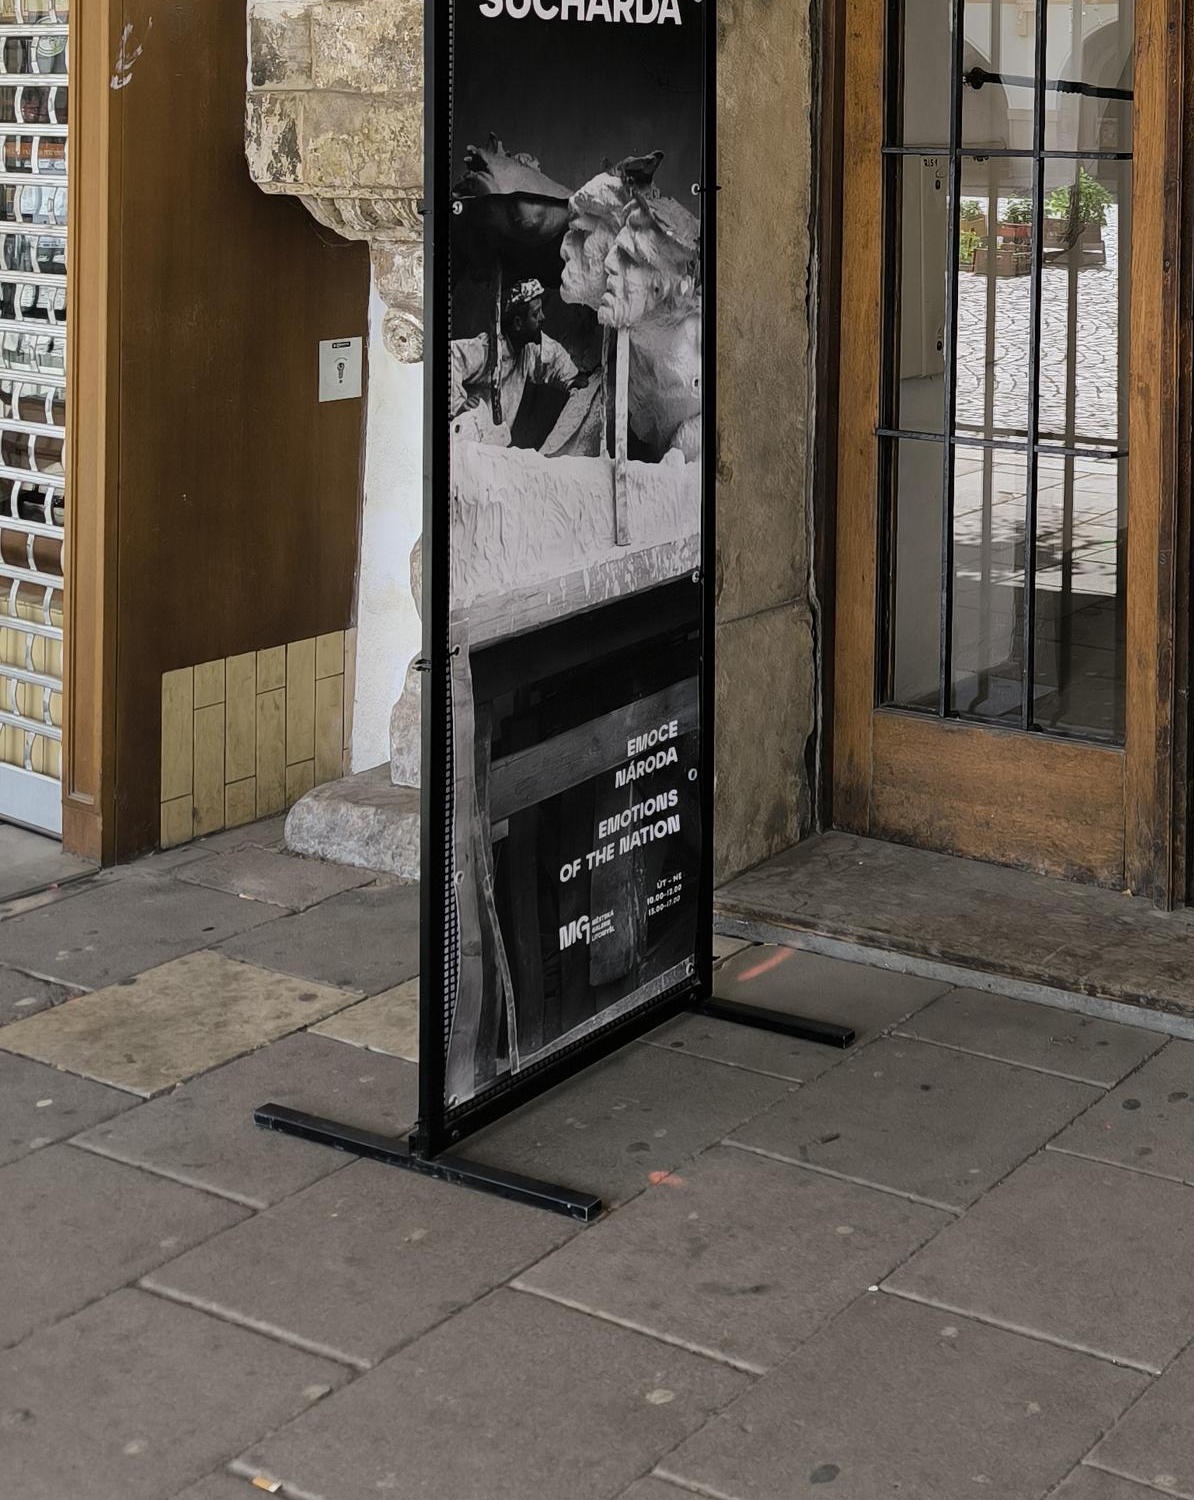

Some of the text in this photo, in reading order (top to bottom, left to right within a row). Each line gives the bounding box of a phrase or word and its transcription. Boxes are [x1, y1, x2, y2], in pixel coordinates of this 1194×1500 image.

[627, 720, 678, 757] EMOCE
[615, 746, 678, 788] NÁRODA
[598, 789, 678, 839] EMOTIONS
[559, 814, 680, 883] OF THE NATION
[559, 915, 590, 950] MG
